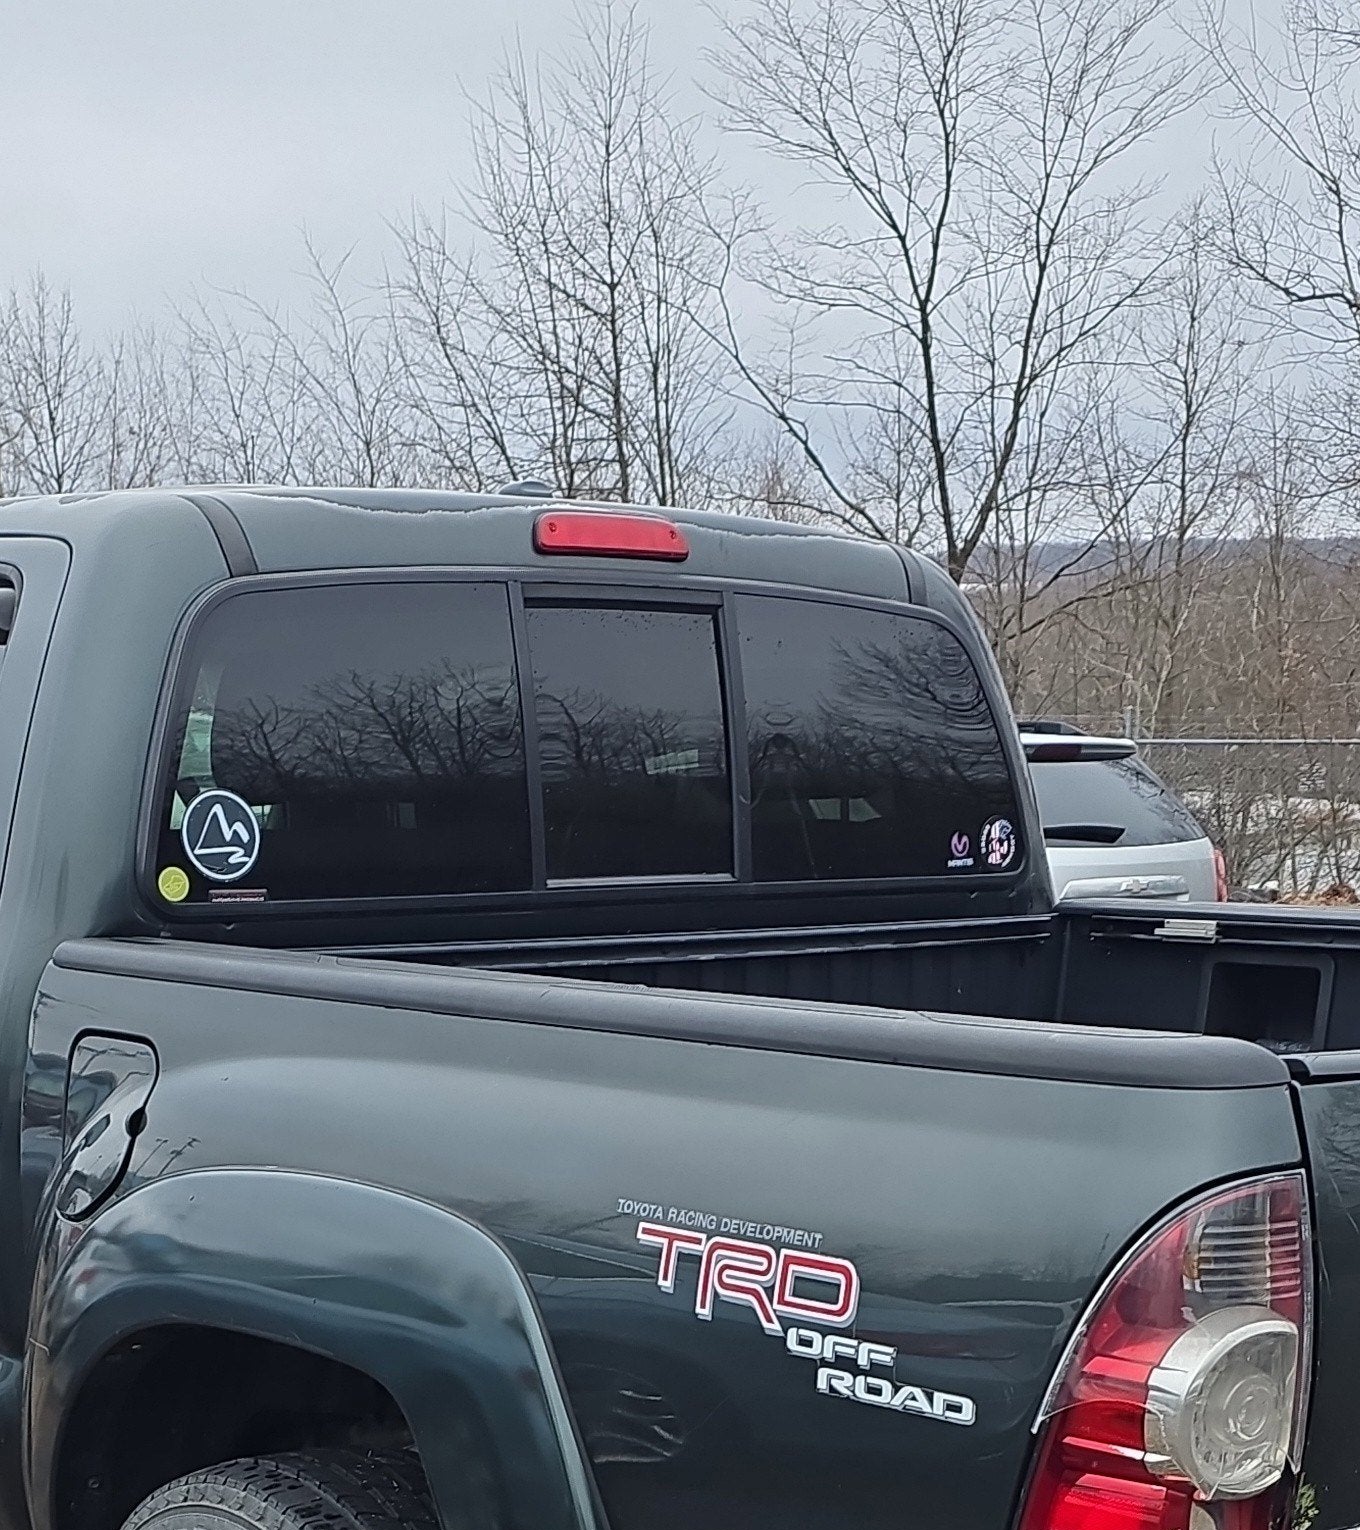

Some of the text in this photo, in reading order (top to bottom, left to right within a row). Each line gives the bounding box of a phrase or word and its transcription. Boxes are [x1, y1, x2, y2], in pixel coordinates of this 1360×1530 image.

[617, 1198, 823, 1250] TOYOTA RACING DEVELOPMENT
[636, 1221, 860, 1337] TRD
[786, 1327, 898, 1370] OFF
[816, 1366, 976, 1426] ROAD
